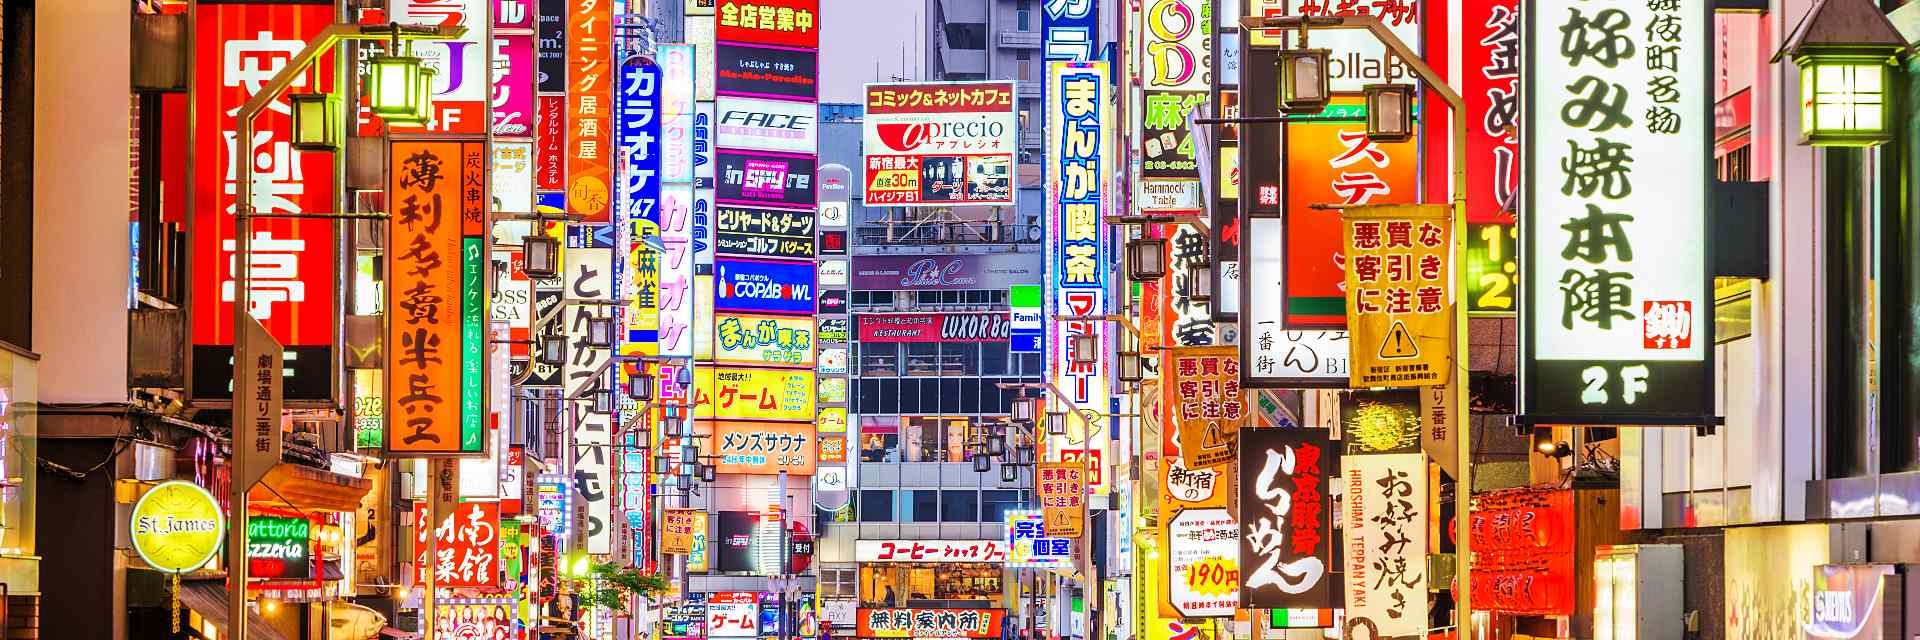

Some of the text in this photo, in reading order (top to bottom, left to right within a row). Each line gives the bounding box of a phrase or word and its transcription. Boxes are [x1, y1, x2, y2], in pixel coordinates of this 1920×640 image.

[720, 2, 813, 33] 全店営業中
[869, 89, 1011, 108] コミック&ネットカフェ
[720, 109, 814, 130] FACE
[695, 112, 708, 168] SEGA
[934, 141, 1001, 149] アプレシオ
[549, 154, 558, 185] ホステル
[869, 156, 919, 170] 新宿最大
[1559, 0, 1636, 330] 好み焼本陣
[222, 31, 305, 320] 安楽亭
[1064, 78, 1097, 284] まんが喫茶
[869, 191, 919, 202] ハイジアB1
[1143, 182, 1184, 195] Hammock
[1152, 195, 1177, 205] Table
[694, 198, 708, 253] SEGA
[717, 209, 814, 235] ビリヤード&ダーツ
[1353, 219, 1445, 250] 悪質な
[637, 247, 658, 309] 麻雀
[1354, 254, 1443, 282] 客引き
[1355, 286, 1444, 315] に注意
[718, 317, 811, 352] まんが喫茶
[942, 313, 1010, 340] LUXOR Ba
[1257, 319, 1275, 376] 一番街
[1655, 338, 1680, 349] すき
[1179, 357, 1239, 376] 悪質な
[718, 383, 778, 410] ゲーム
[1179, 379, 1239, 399] 客引き
[255, 354, 273, 453] 劇場通り一番街
[1181, 400, 1240, 420] に注意
[722, 431, 807, 453] メンズサウナ
[1042, 468, 1080, 481] 悪質な
[1169, 465, 1213, 490] 新宿
[1042, 482, 1080, 495] 客引き
[1184, 488, 1199, 499] の
[1349, 469, 1363, 530] HIROSHIMA
[1043, 495, 1081, 508] に注意
[248, 518, 308, 538] attoria
[877, 542, 939, 560] コーヒー
[1031, 538, 1071, 557] 個室
[1371, 467, 1422, 619] お好み焼き
[1189, 562, 1239, 586] 190円
[711, 613, 755, 629] ゲーム
[869, 609, 980, 631] 無料案内所
